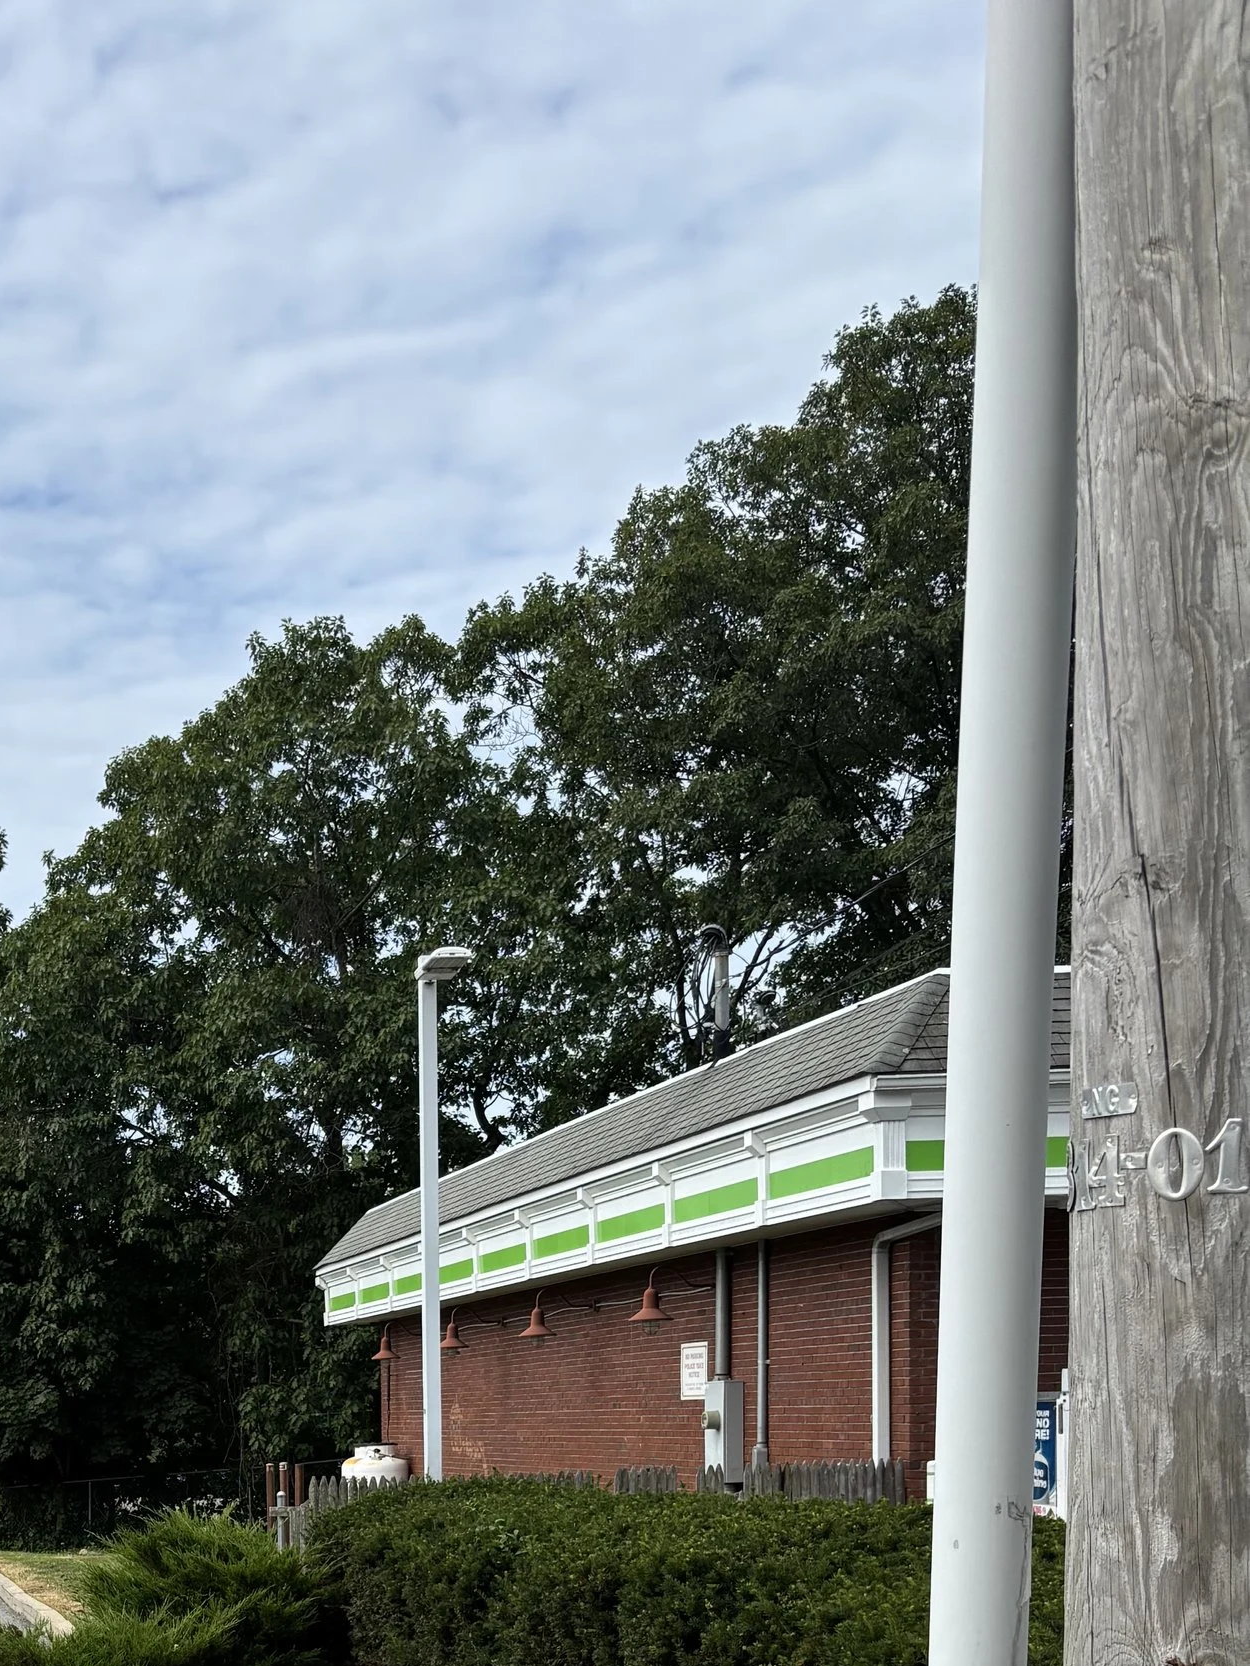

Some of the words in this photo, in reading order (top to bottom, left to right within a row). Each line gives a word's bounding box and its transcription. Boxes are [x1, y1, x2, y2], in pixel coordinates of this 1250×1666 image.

[1036, 1409, 1050, 1418] OUR
[1036, 1417, 1050, 1429] NO
[1035, 1429, 1050, 1441] RE!
